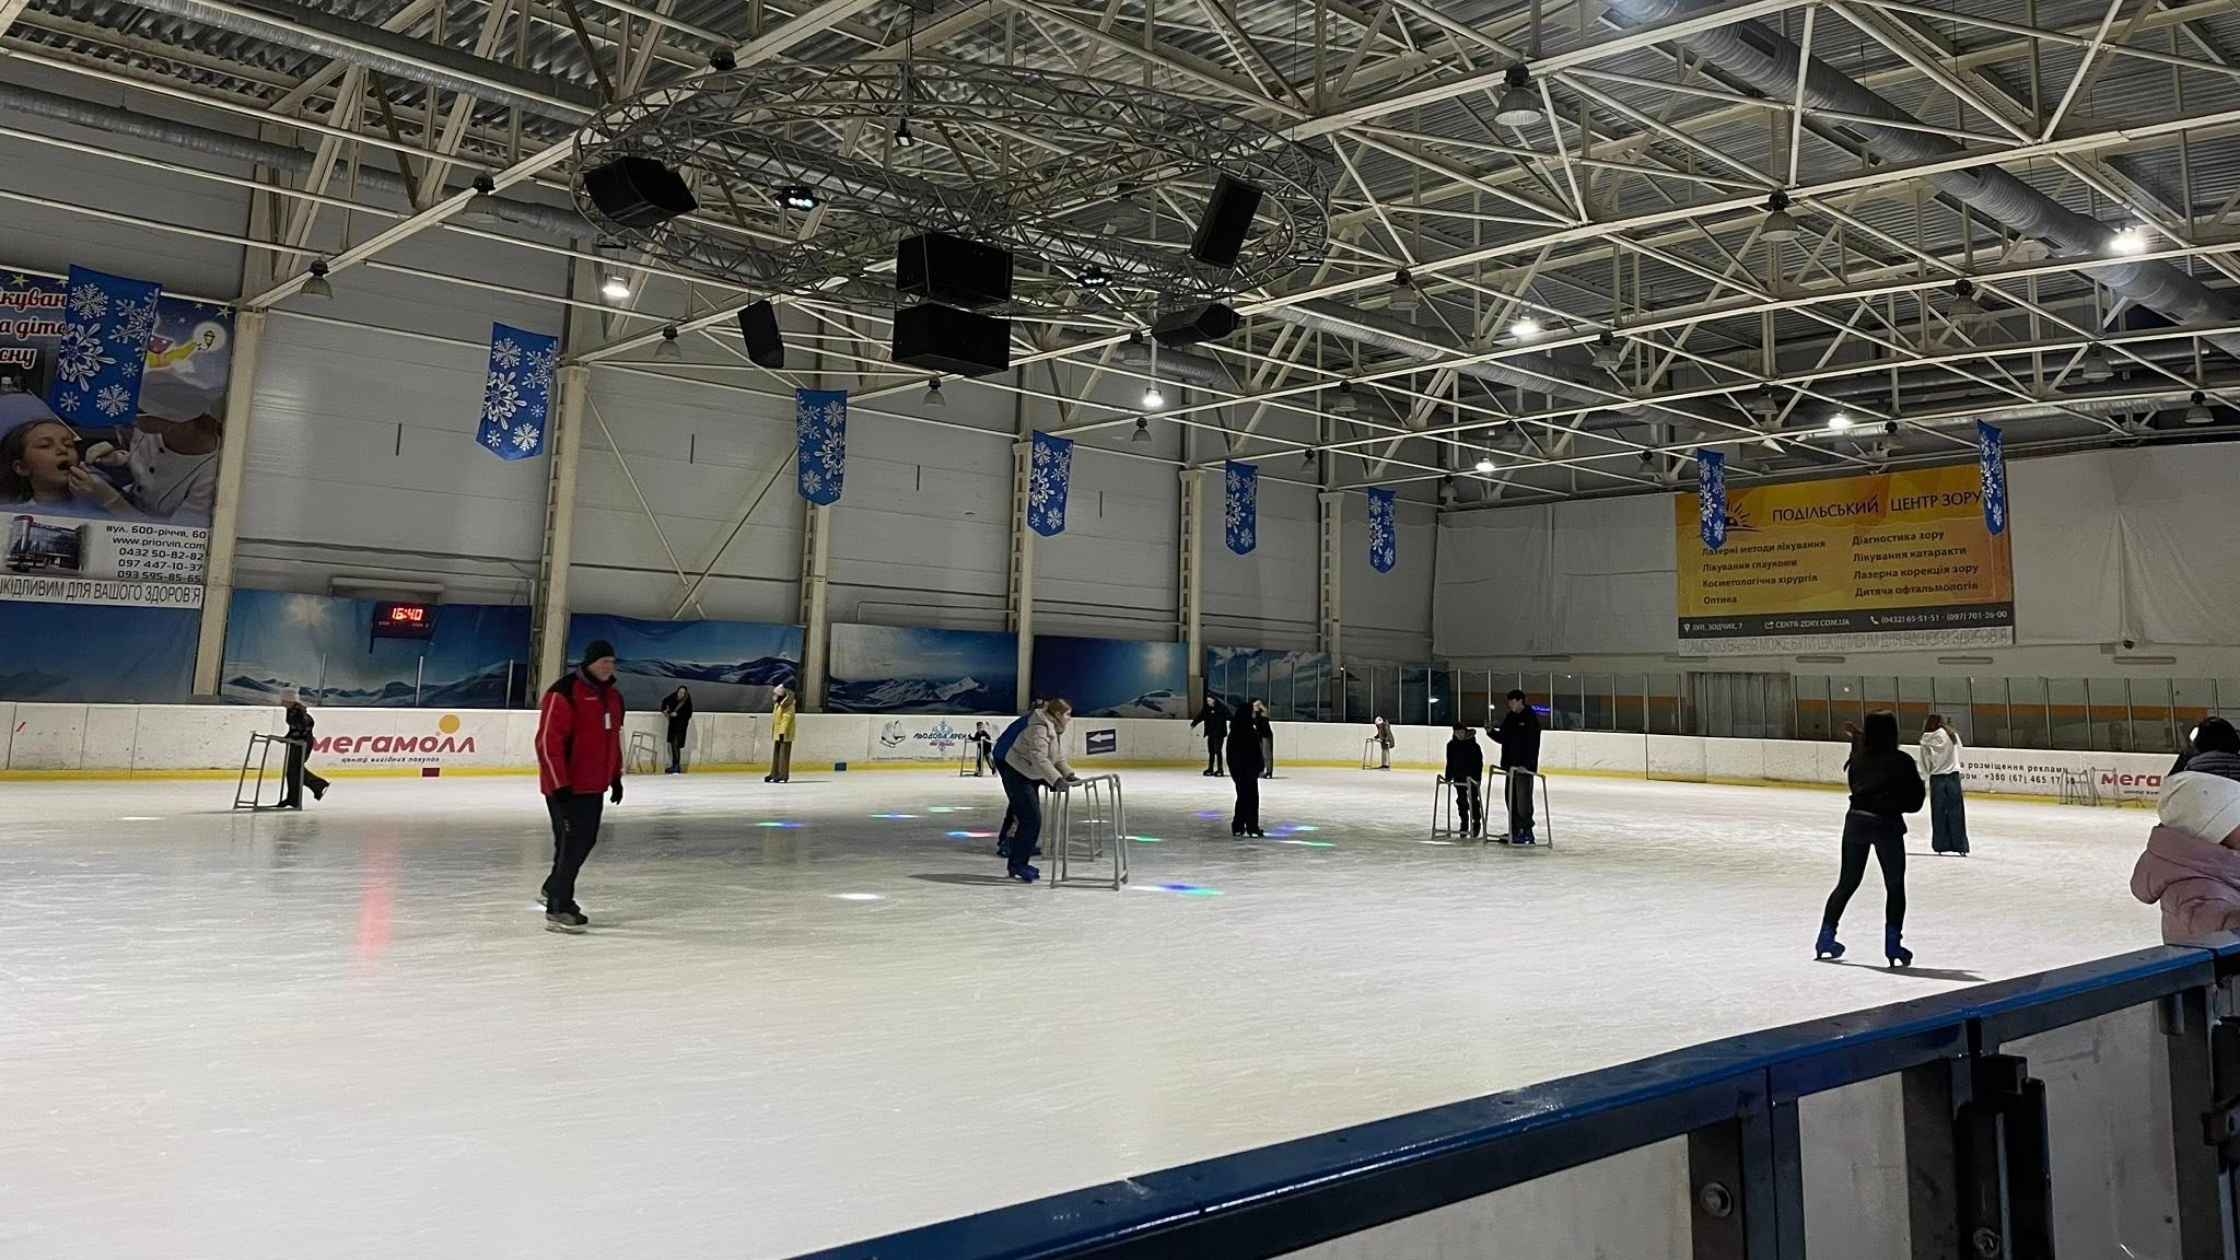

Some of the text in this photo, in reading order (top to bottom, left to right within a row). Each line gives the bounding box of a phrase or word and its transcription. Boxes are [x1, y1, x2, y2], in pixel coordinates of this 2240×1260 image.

[0, 288, 67, 312] куван
[1772, 490, 1983, 522] ПОДІЛЬСЬКИЙ ЦЕНТР ЗОРУ
[192, 530, 207, 539] 60
[1851, 530, 1945, 546] Діагностика зору
[112, 537, 206, 550] www.priorvin.com
[1740, 543, 1775, 554] методи
[1777, 540, 1826, 553] лікування
[119, 547, 204, 561] 0432 50-82-82
[1853, 546, 1967, 564] Лікування катаракти
[118, 559, 203, 572] 097 447-10-37
[1702, 559, 1798, 573] Лікування глаукоми
[1854, 563, 1979, 581] Лазерна корекція зору
[117, 570, 201, 584] 093 595-85-65
[1702, 574, 1818, 589] Косметологічна хірургія
[66, 582, 94, 601] ДЛЯ
[94, 583, 142, 602] ВАШОГО
[145, 586, 201, 605] ЗДОРОВ'Я
[1855, 581, 1978, 599] Дитяча офтальмологія
[1703, 595, 1738, 606] Оптика
[392, 607, 423, 621] 16:40
[1968, 762, 2024, 771] розміщення
[2101, 773, 2162, 788] мега
